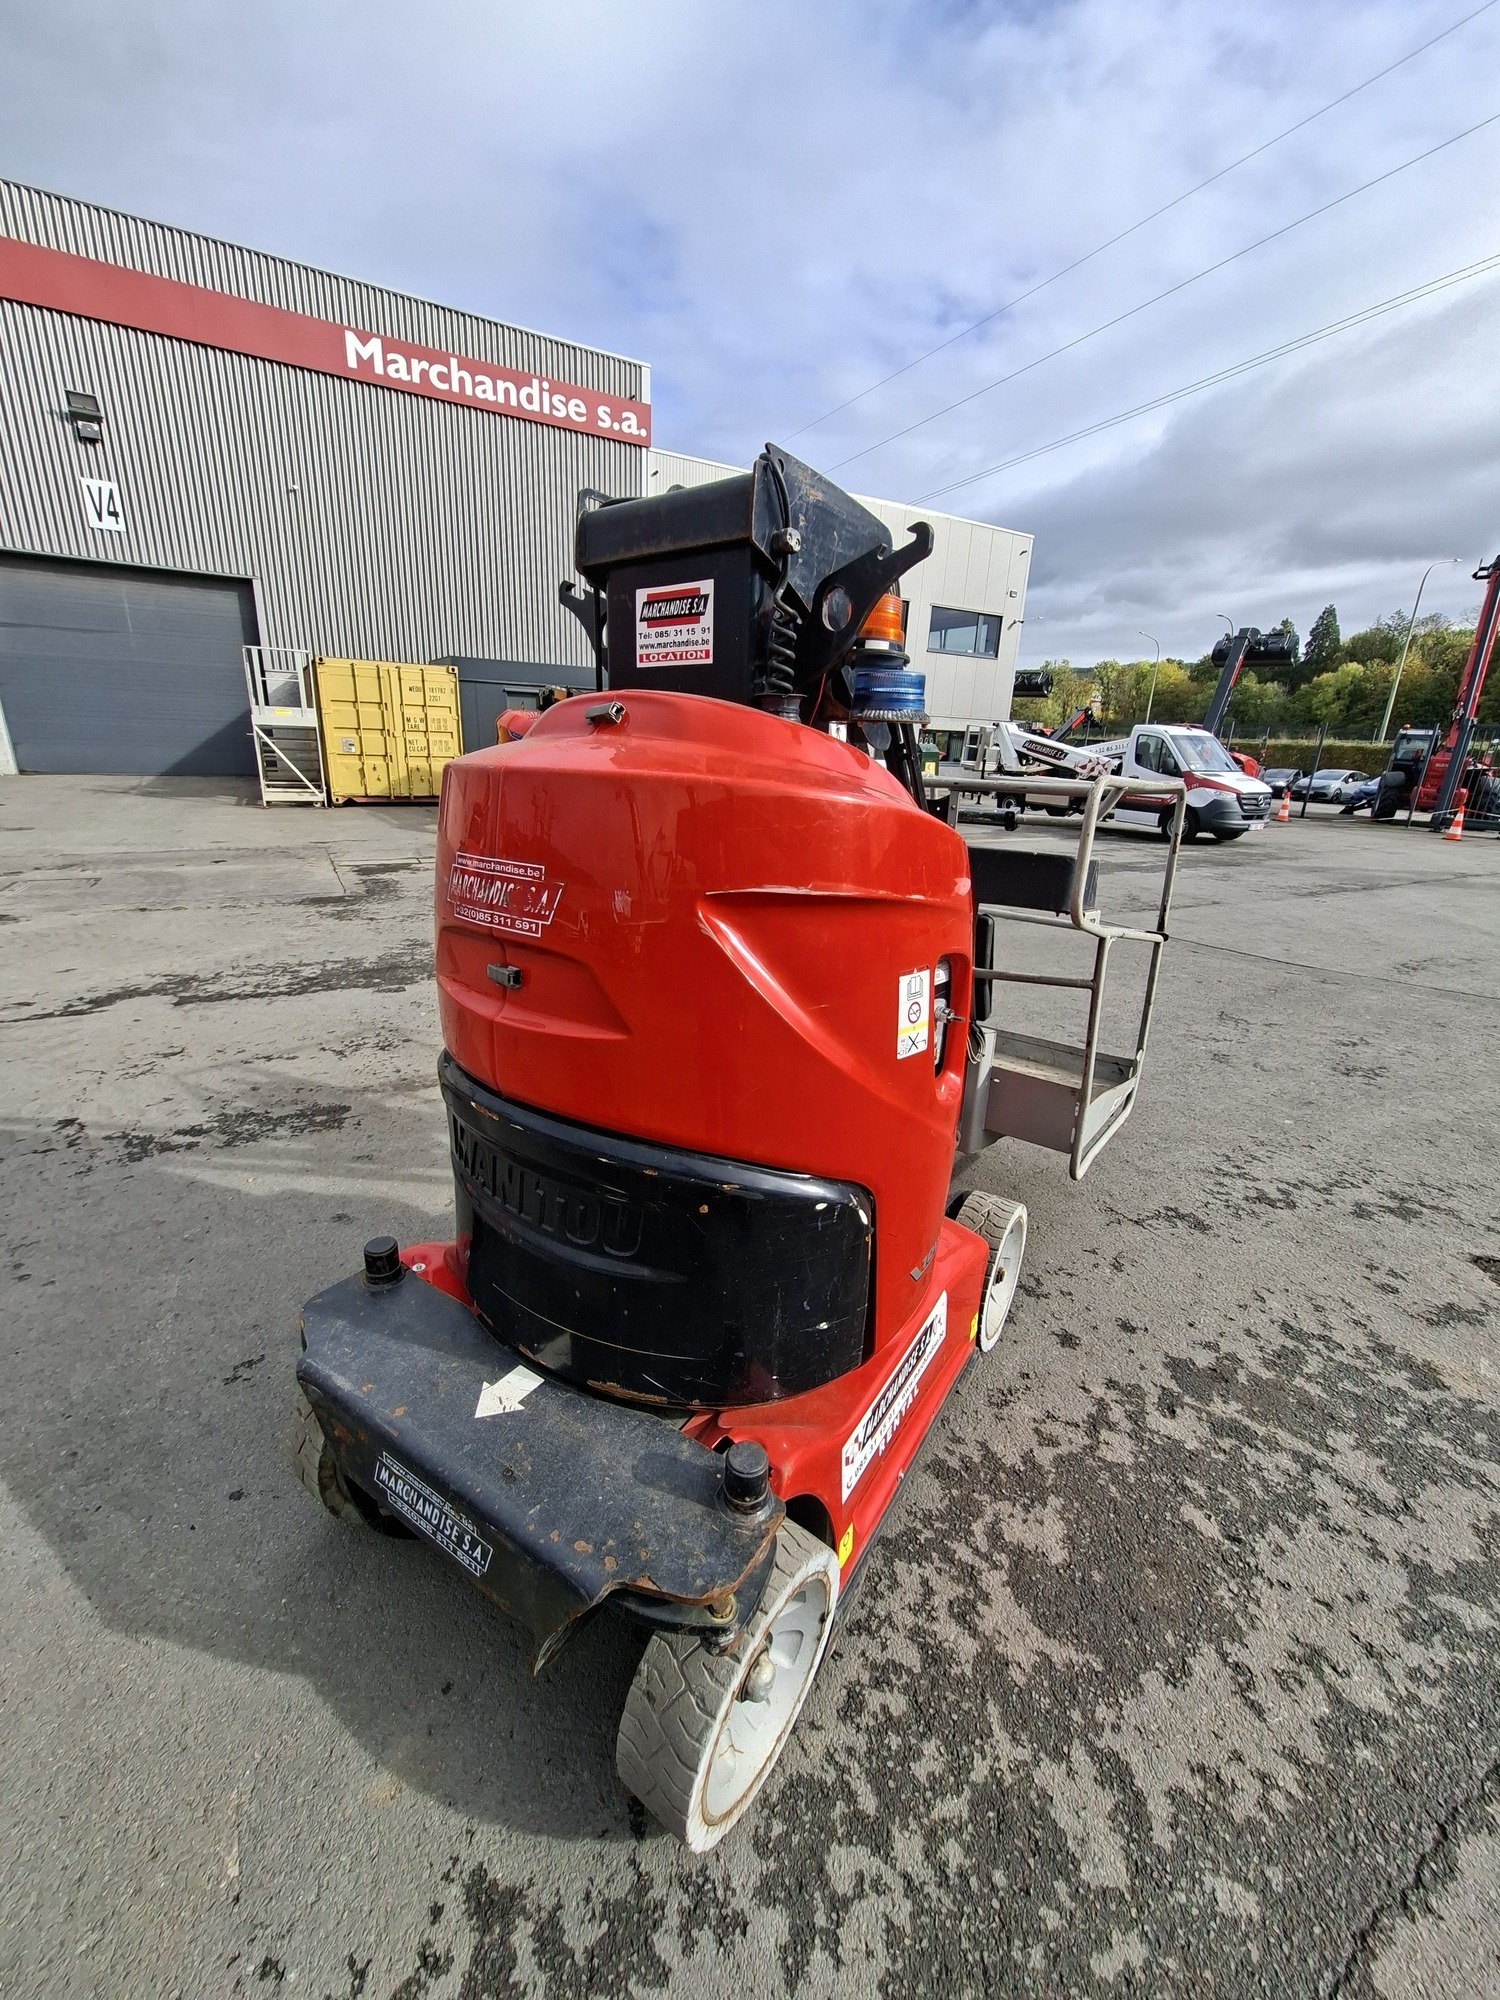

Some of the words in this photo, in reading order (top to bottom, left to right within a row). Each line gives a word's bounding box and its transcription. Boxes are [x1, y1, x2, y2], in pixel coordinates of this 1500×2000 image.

[344, 329, 587, 423] Marchandise
[597, 404, 648, 438] s.a.
[86, 484, 120, 526] V4
[641, 598, 692, 619] MARCHANDISE
[638, 631, 653, 640] Tél:
[673, 629, 683, 637] 31
[687, 627, 696, 635] 15
[701, 626, 711, 635] 91
[639, 637, 710, 651] www.marchandise.be
[642, 650, 706, 662] LOCATION
[1024, 740, 1056, 756] MARCHANDISE
[457, 857, 541, 878] www.marchandise.be
[456, 907, 492, 921] +32(0)85
[493, 914, 511, 927] 311
[515, 920, 537, 932] 591
[879, 1384, 919, 1457] RENTAL
[379, 1466, 461, 1543] MARCHANDISE
[462, 1533, 485, 1565] S.A.
